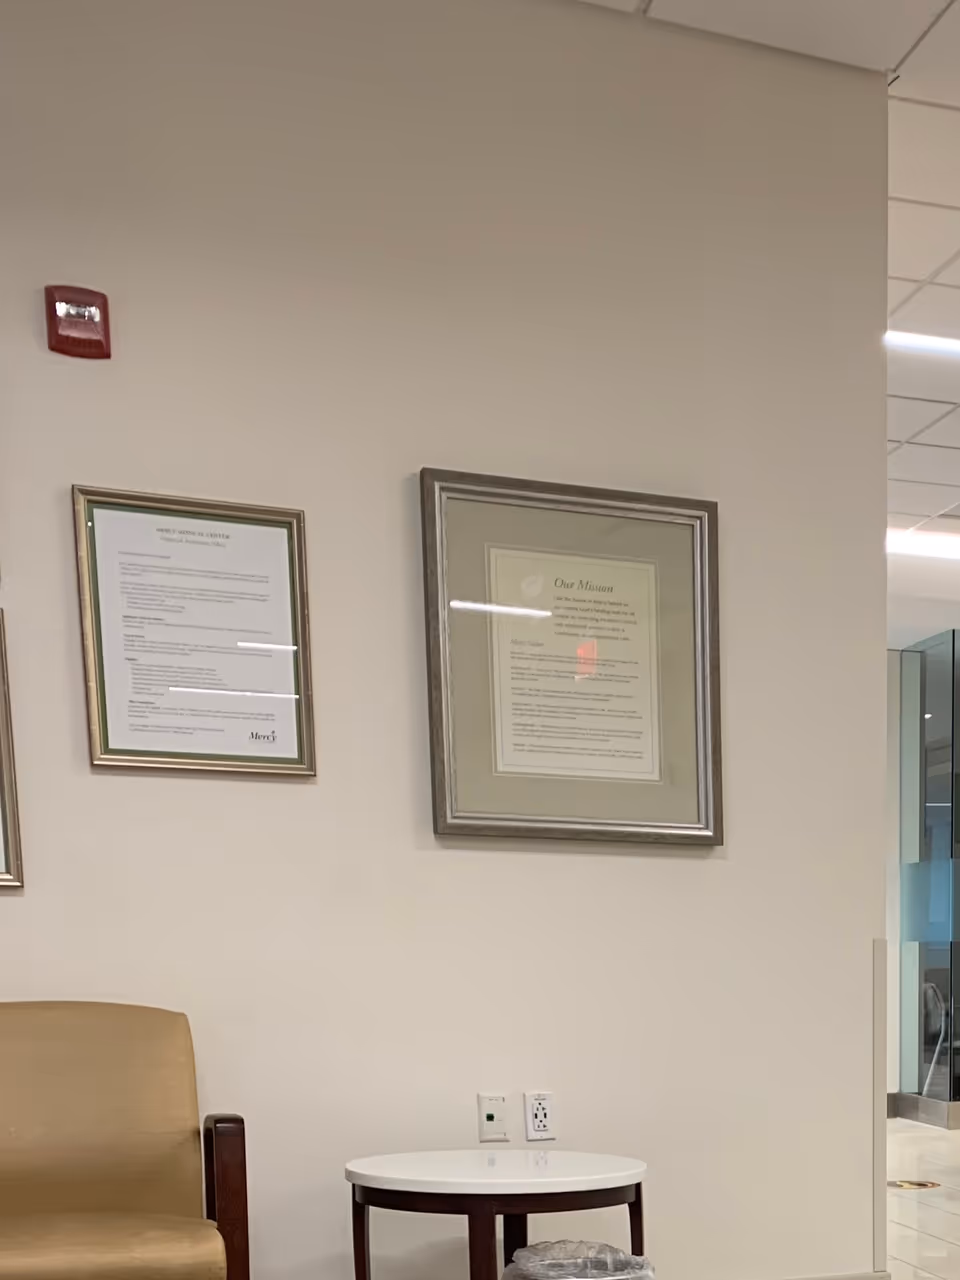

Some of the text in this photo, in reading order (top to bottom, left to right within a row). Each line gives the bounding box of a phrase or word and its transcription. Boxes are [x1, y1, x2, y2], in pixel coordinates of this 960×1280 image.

[554, 577, 614, 593] Our Mission
[249, 730, 277, 742] Mercy
